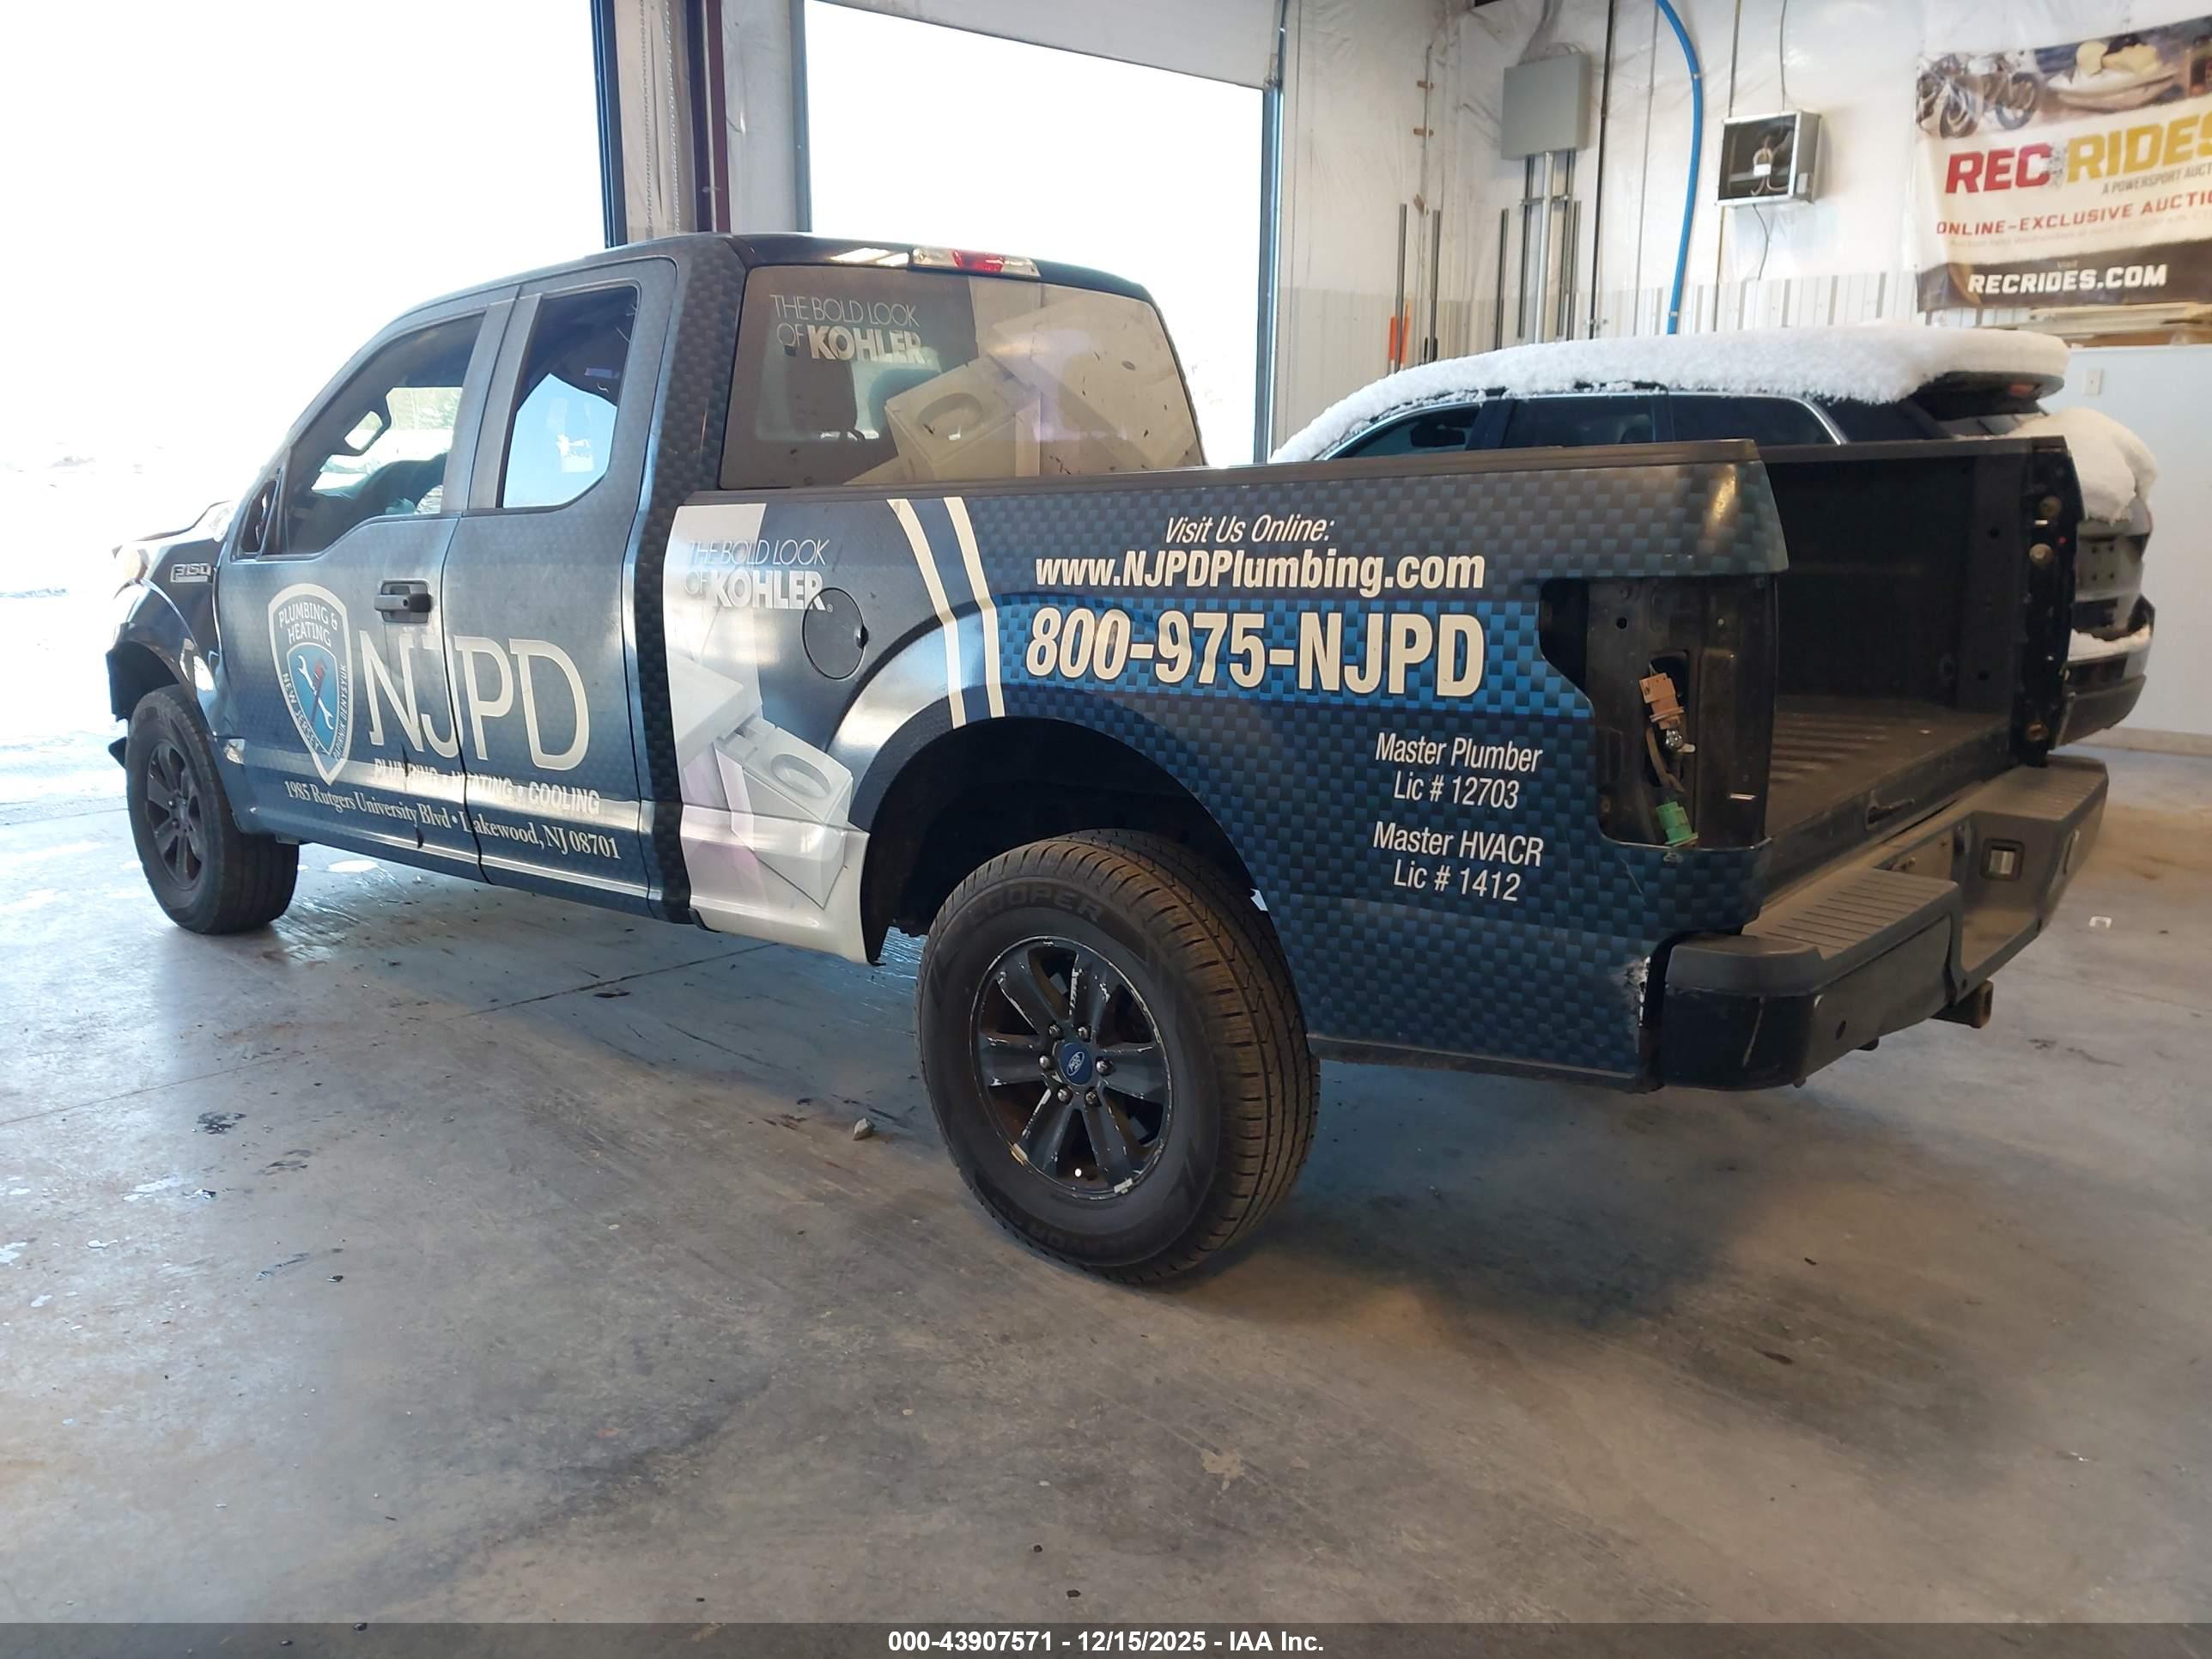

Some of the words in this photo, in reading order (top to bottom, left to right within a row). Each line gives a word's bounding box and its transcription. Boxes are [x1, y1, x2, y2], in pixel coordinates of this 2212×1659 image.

[1945, 142, 2054, 194] REC
[1936, 203, 2134, 236] ONLINE-EXCLUSIVE
[1967, 264, 2168, 295] RECRIDES.COM
[769, 295, 809, 320] THE
[811, 296, 864, 323] BOLD
[866, 301, 921, 328] LOOK
[776, 322, 805, 347] OF
[806, 324, 927, 365] KOHLER
[1164, 516, 1208, 544] Visit
[1215, 516, 1246, 543] Us
[1250, 514, 1336, 543] Online:
[688, 539, 718, 564] THE
[719, 539, 771, 565] BOLD
[773, 538, 830, 567] LOOK
[1035, 548, 1486, 598] www.NJPDPlumbing.com
[685, 571, 708, 596] OF
[711, 568, 827, 611] KOHLER
[278, 601, 329, 629] PLUMBING
[331, 612, 338, 631] &
[287, 621, 331, 647] HEATING
[1024, 606, 1486, 698] 800-975-NJPD
[283, 672, 298, 704] NEW
[295, 709, 320, 752] JERSEY
[358, 630, 591, 771] NJPD
[1375, 732, 1448, 766] Master
[1450, 737, 1544, 773] Plumber
[451, 769, 514, 797] HATING
[528, 781, 600, 815] COOLING
[1394, 770, 1425, 801] Lic
[1429, 774, 1444, 803] #
[1452, 775, 1520, 810] 12703
[284, 781, 310, 801] 1985
[309, 783, 356, 814] Rutgers
[354, 791, 417, 828] University
[416, 803, 452, 829] Blvd
[459, 811, 545, 850] Lakewood,
[541, 824, 568, 855] NJ
[568, 830, 622, 860] 08701
[1373, 820, 1455, 857] Master
[1459, 830, 1545, 867] HVACR
[1394, 859, 1428, 890] Lic
[1434, 864, 1451, 892] #
[1460, 866, 1521, 902] 1412
